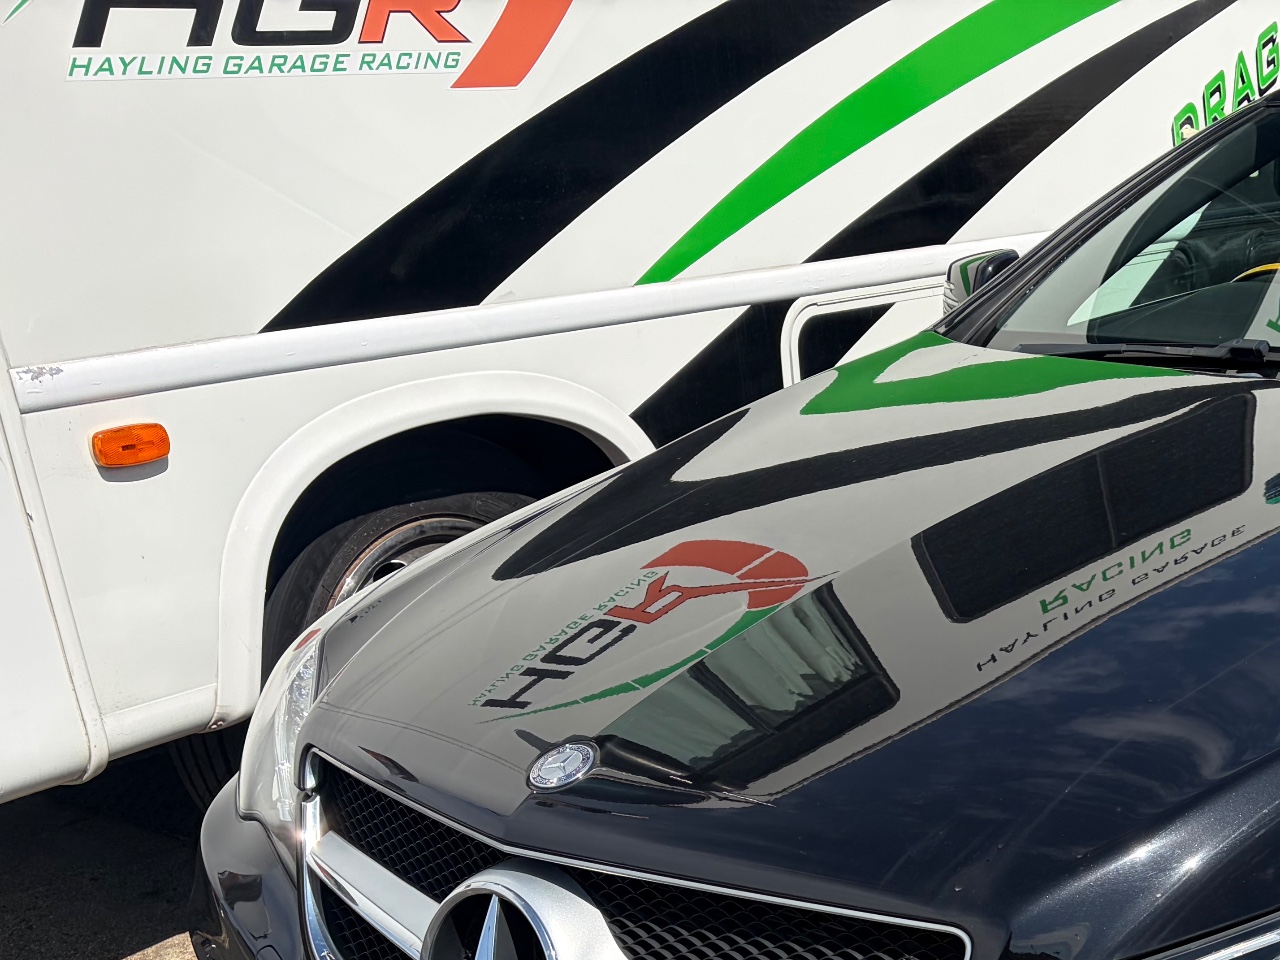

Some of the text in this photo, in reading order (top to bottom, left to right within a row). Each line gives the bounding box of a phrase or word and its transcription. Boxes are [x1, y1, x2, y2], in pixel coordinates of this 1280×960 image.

[68, 51, 461, 77] HAYLING GARAGE RACING
[1171, 21, 1280, 147] DRAG
